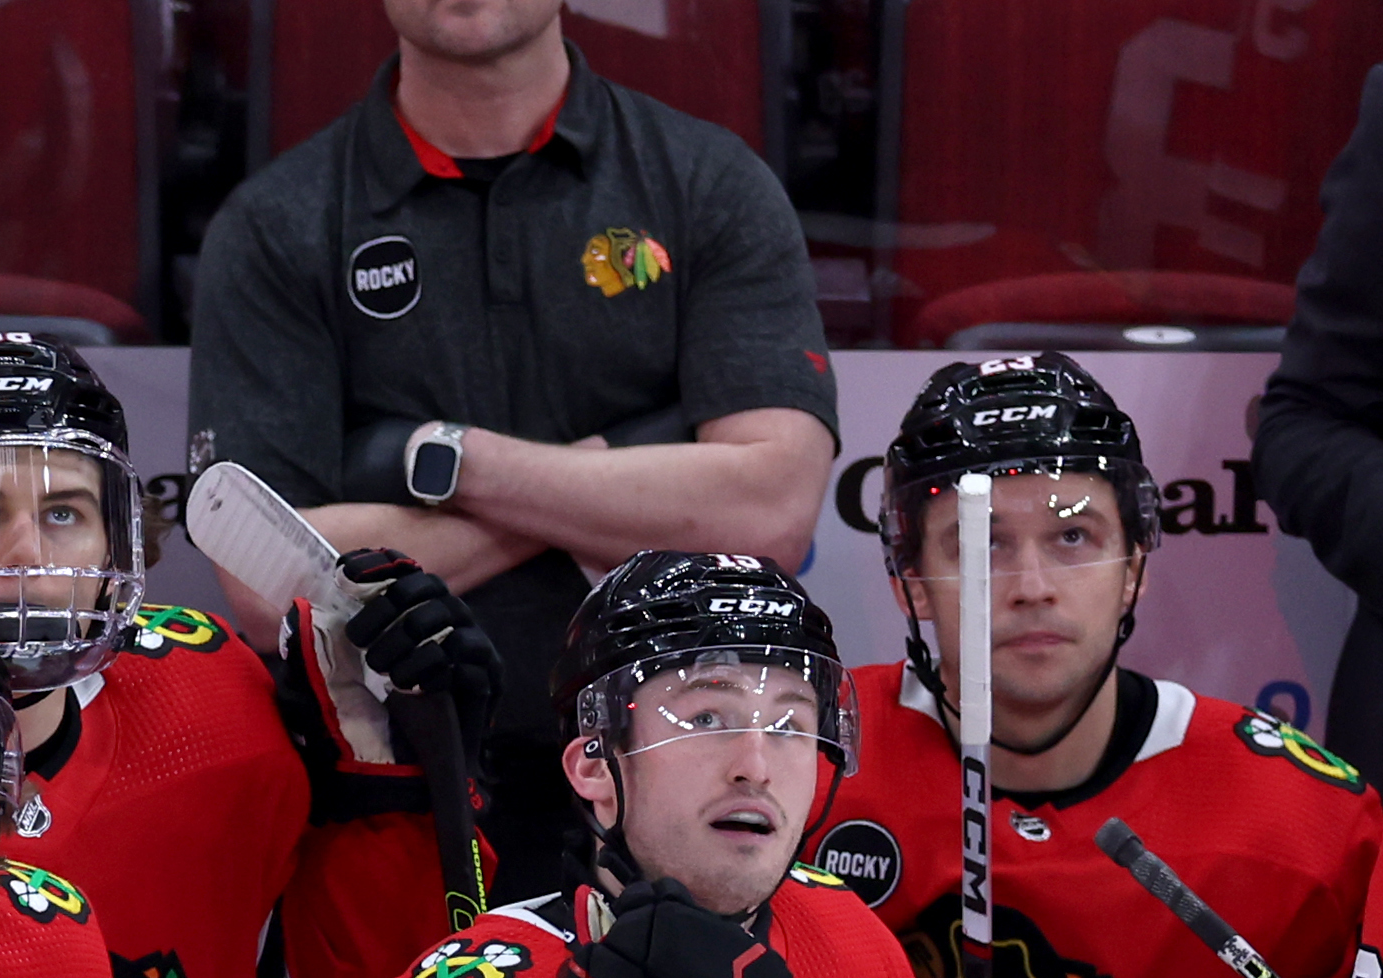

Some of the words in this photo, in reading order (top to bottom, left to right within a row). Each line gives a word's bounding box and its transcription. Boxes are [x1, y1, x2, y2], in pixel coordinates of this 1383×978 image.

[355, 257, 414, 292] ROCKY
[972, 404, 1057, 427] CCM
[708, 598, 795, 617] CCM
[963, 755, 988, 916] CCM
[824, 849, 892, 881] ROCKY
